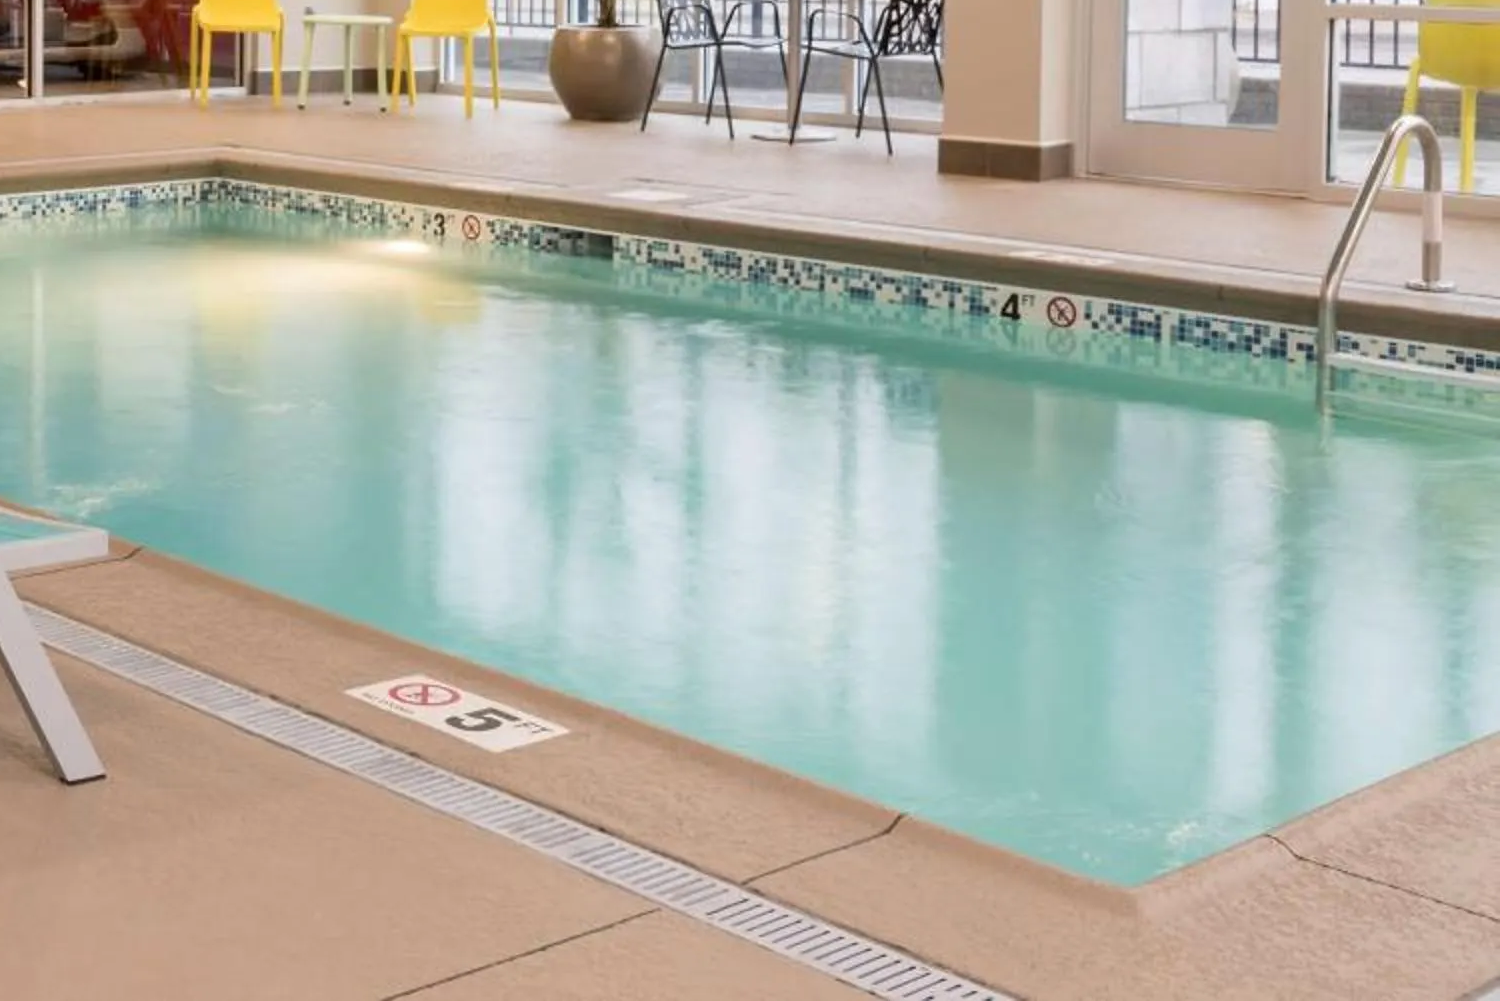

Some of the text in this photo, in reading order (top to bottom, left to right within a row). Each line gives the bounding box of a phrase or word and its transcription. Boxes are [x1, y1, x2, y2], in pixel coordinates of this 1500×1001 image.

[433, 212, 445, 237] 3
[1000, 293, 1036, 321] 4 FT
[445, 706, 522, 732] 5
